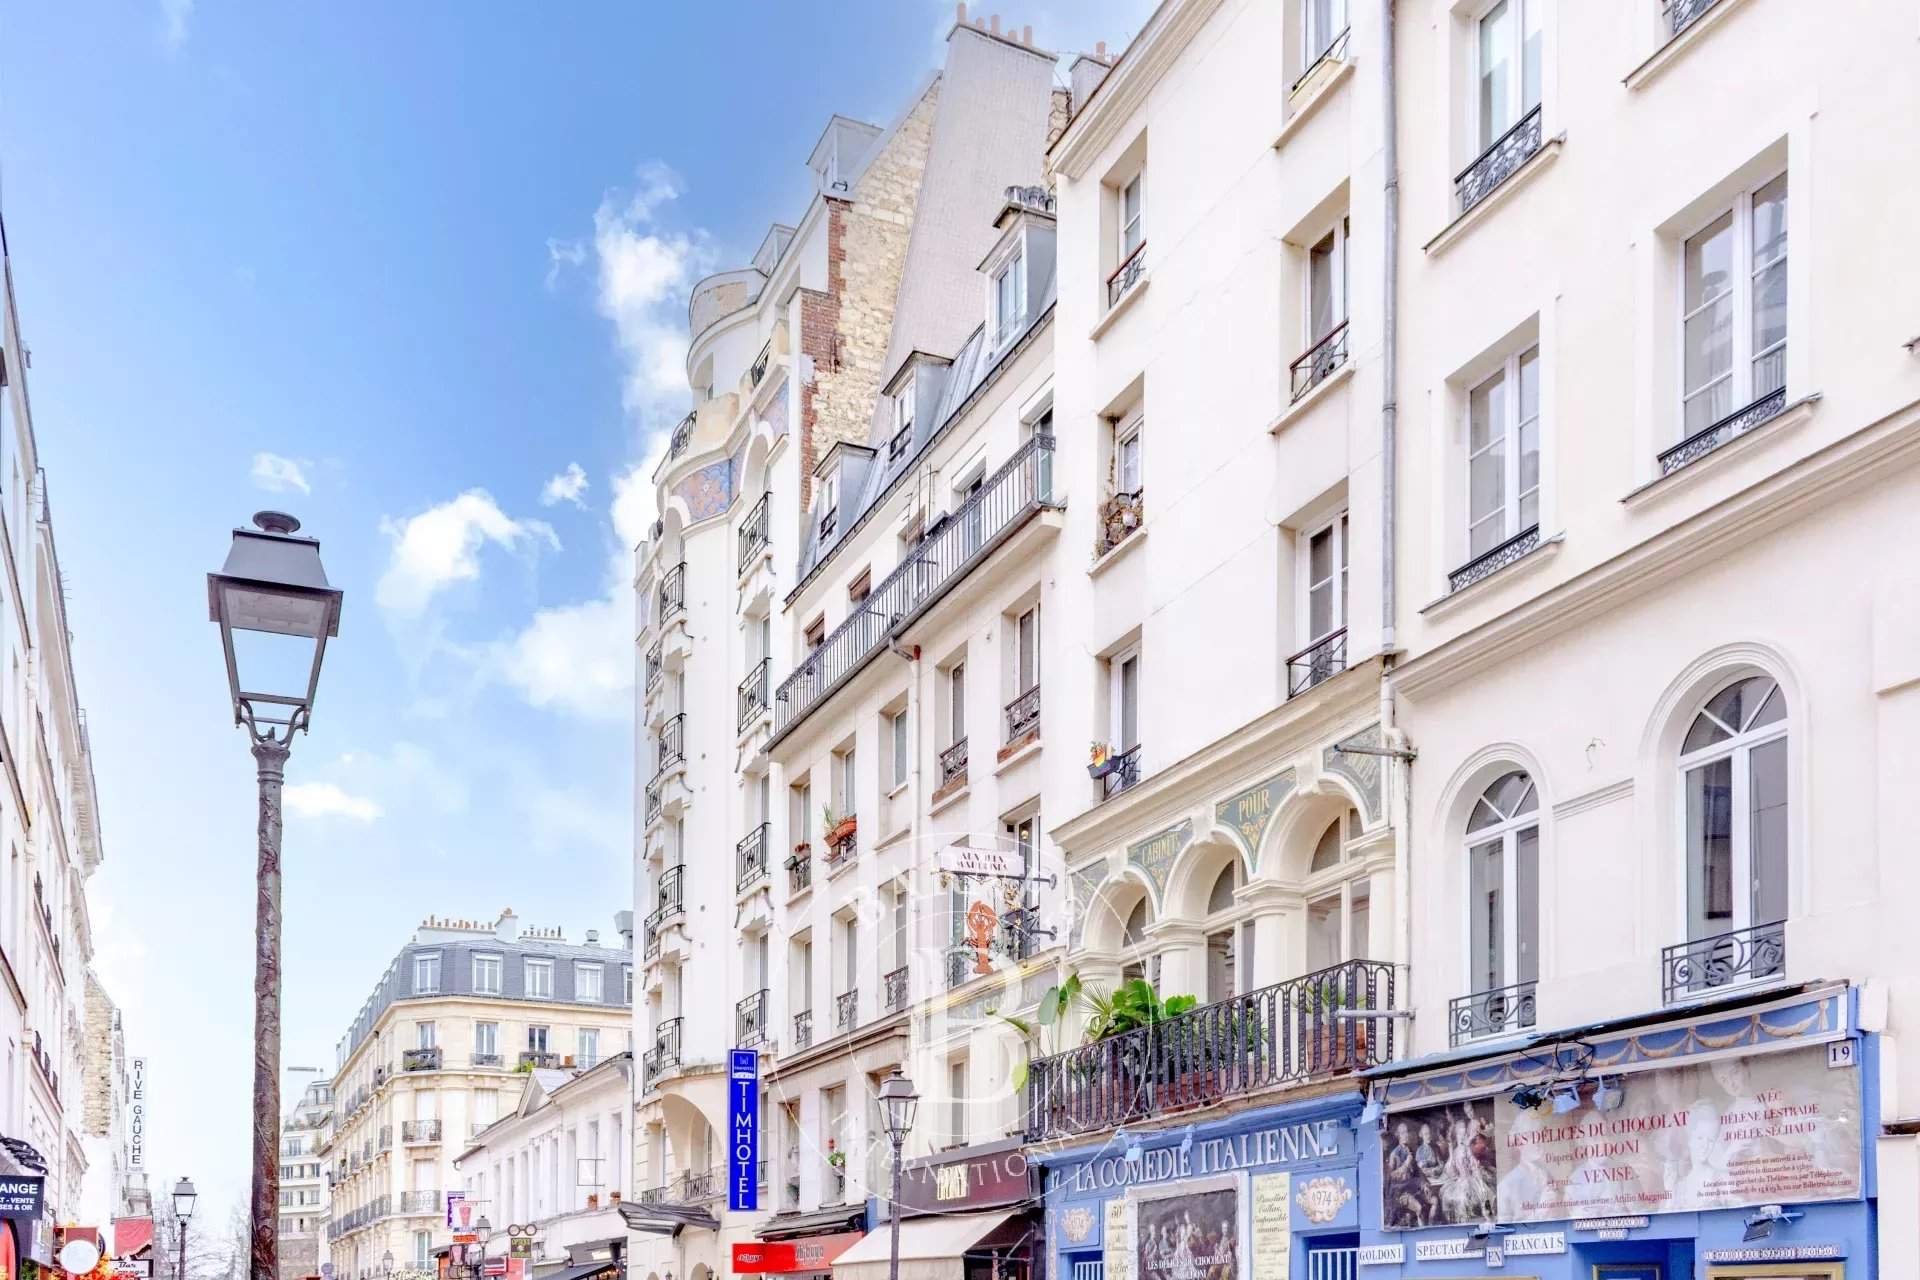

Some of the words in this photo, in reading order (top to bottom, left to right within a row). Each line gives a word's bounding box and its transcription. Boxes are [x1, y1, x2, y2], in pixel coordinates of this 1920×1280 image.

[1239, 789, 1270, 821] POUR
[1830, 1046, 1851, 1062] 19
[133, 1060, 143, 1100] RIVE
[1764, 1103, 1820, 1120] LESTRADE
[132, 1105, 143, 1164] GAUCHE
[735, 1081, 753, 1209] TIMHOTEL
[1507, 1133, 1529, 1148] LES
[1532, 1125, 1585, 1145] DÉLICES
[1589, 1124, 1609, 1137] DU
[1612, 1111, 1690, 1134] CHOCOLAT
[1075, 1162, 1097, 1192] LA
[1200, 1119, 1338, 1174] ITALIENNE
[1574, 1139, 1640, 1160] GOLDONI
[1584, 1166, 1634, 1183] VENISE
[1360, 1247, 1401, 1261] GOLDONI
[1488, 1251, 1501, 1263] EN
